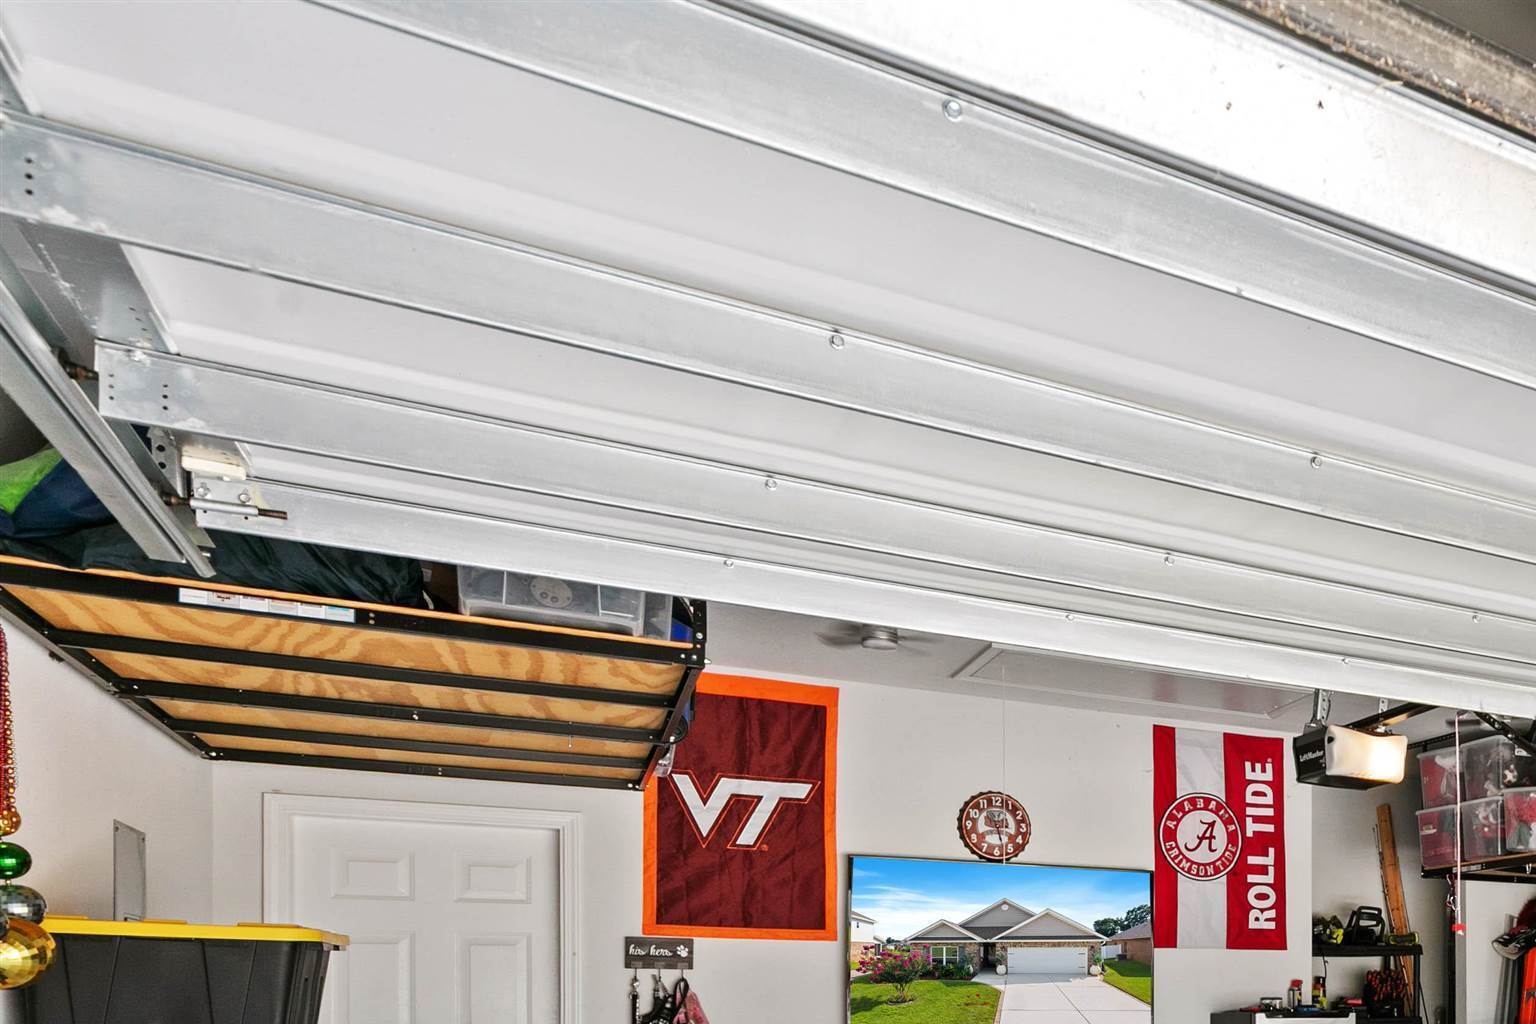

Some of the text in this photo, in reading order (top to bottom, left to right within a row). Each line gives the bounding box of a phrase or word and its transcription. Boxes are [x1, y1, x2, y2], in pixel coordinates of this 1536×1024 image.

[979, 799, 988, 809] 11
[991, 796, 1002, 806] 12
[1007, 800, 1013, 810] 1
[668, 771, 816, 847] VT
[969, 808, 980, 818] 10
[1015, 810, 1023, 820] 2
[1165, 798, 1237, 832] ALABAMA
[965, 820, 973, 830] 9
[1019, 823, 1027, 833] 3
[970, 833, 978, 843] 8
[1015, 835, 1023, 844] 4
[1184, 819, 1218, 853] A
[981, 843, 988, 852] 7
[1007, 843, 1014, 853] 5
[1244, 760, 1277, 930] ROLL TIDE
[993, 846, 1000, 856] 6
[1165, 841, 1237, 876] CRIMSON TIDE
[628, 943, 674, 957] his hers
